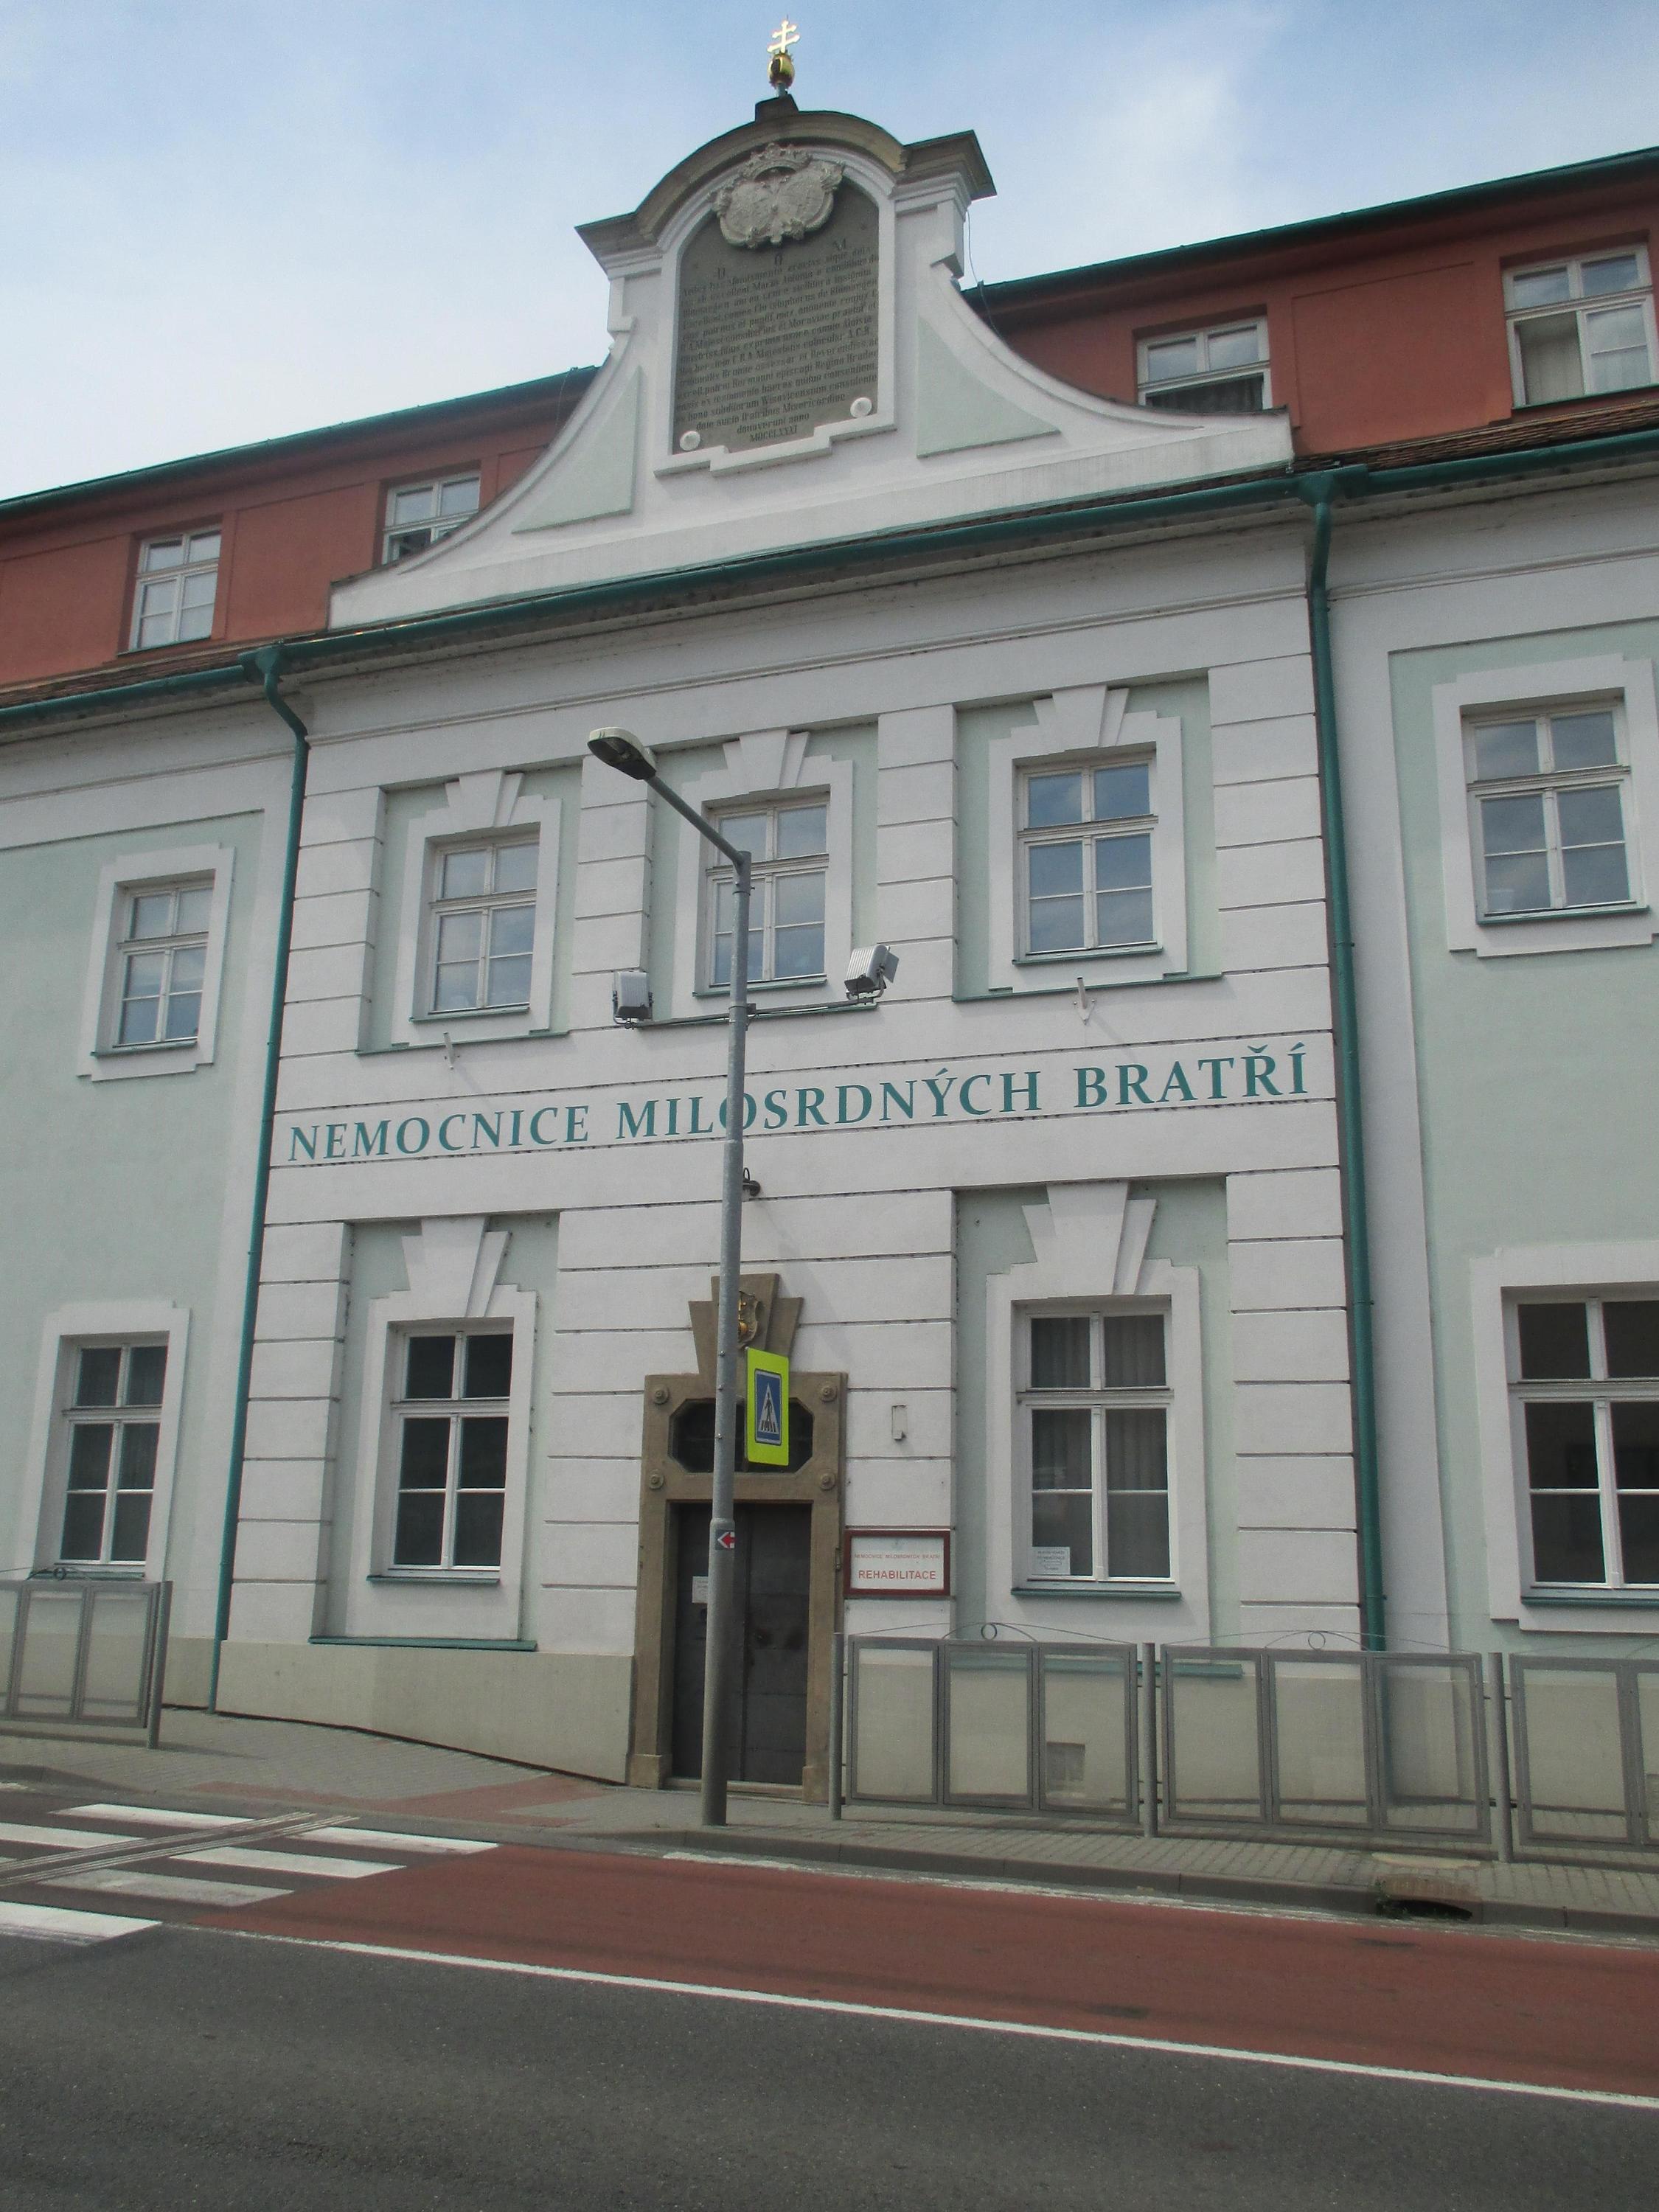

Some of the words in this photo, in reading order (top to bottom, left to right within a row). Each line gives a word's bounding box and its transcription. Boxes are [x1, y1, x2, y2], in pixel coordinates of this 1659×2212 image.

[288, 1104, 589, 1162] NEMOCNICE
[615, 1067, 1041, 1140] MILOSRDNÝCH
[1074, 1041, 1309, 1108] BRATŘÍ
[858, 1570, 936, 1579] REHABILITACE
